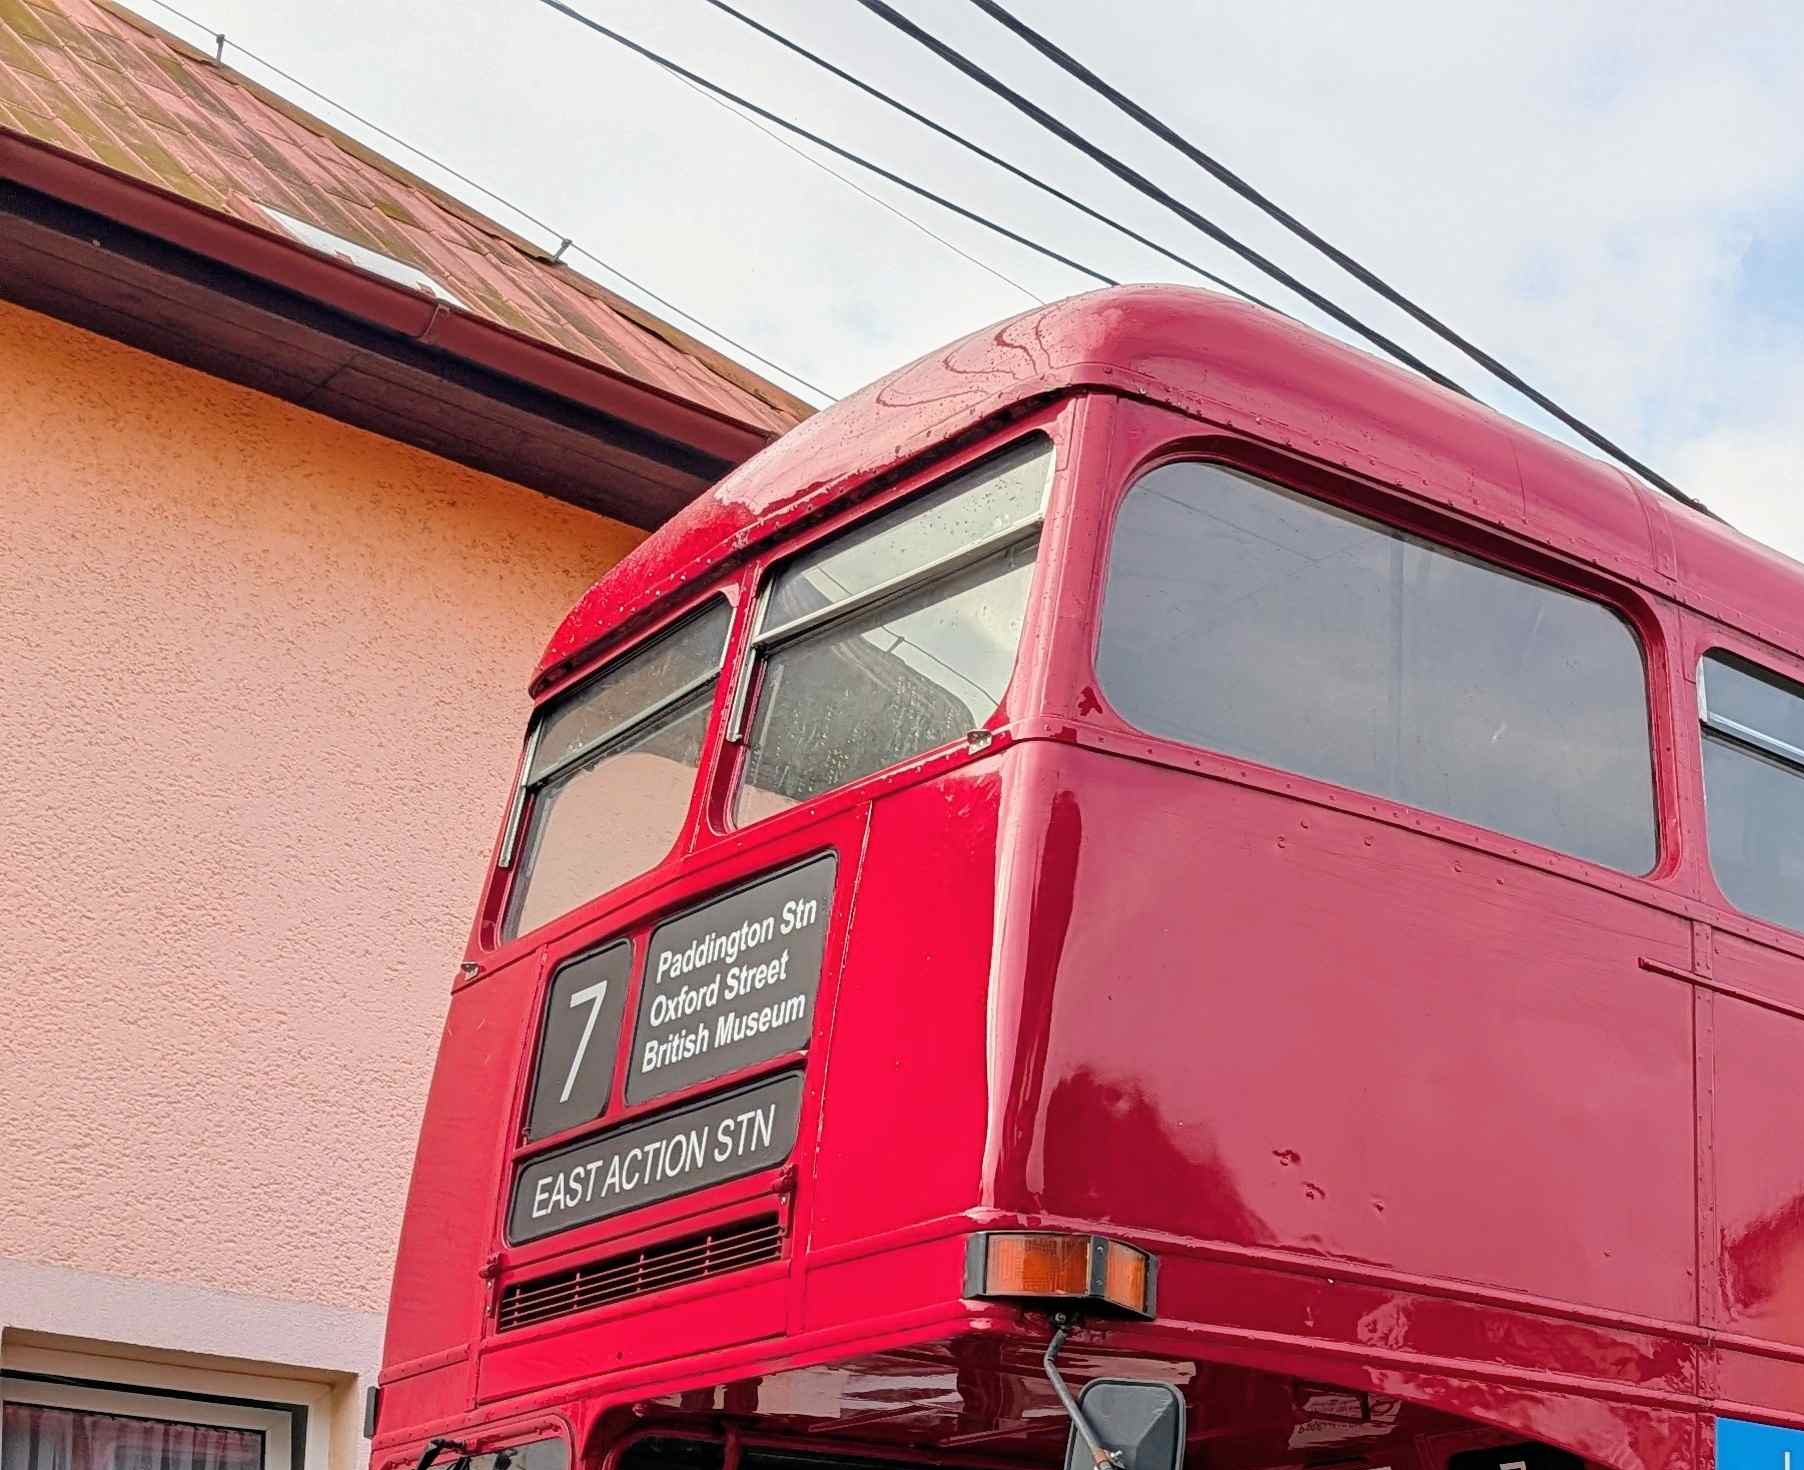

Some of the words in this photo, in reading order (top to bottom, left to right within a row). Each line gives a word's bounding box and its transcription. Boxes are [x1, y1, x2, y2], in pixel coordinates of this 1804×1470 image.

[656, 918, 774, 984] Paddington
[780, 896, 817, 937] Stn
[650, 973, 721, 1028] Oxford
[724, 948, 790, 1001] Street
[559, 979, 608, 1104] 7
[641, 1023, 709, 1073] British
[714, 992, 806, 1049] Museum
[531, 1159, 603, 1219] EAST
[601, 1129, 708, 1198] ACTION
[713, 1103, 777, 1163] STN
